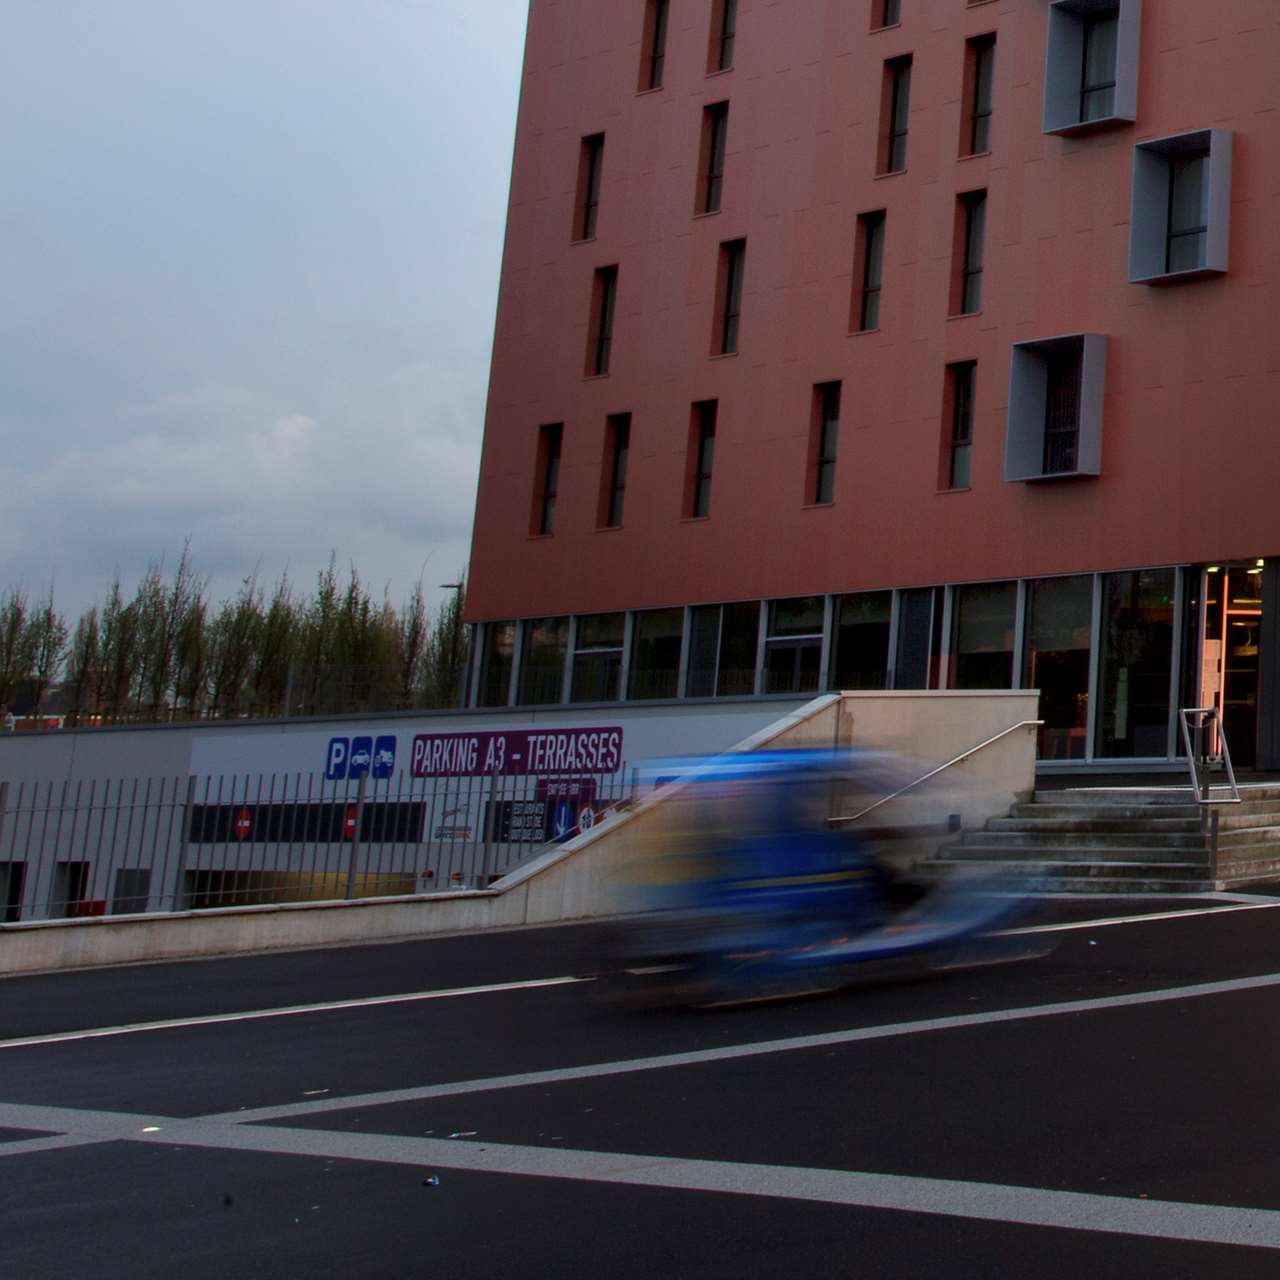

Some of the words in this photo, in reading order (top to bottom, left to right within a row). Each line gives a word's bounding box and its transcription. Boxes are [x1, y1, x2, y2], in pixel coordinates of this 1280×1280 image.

[329, 742, 345, 775] P
[413, 737, 478, 773] PARKING
[484, 736, 506, 771] A3
[527, 732, 619, 770] TERRASSES
